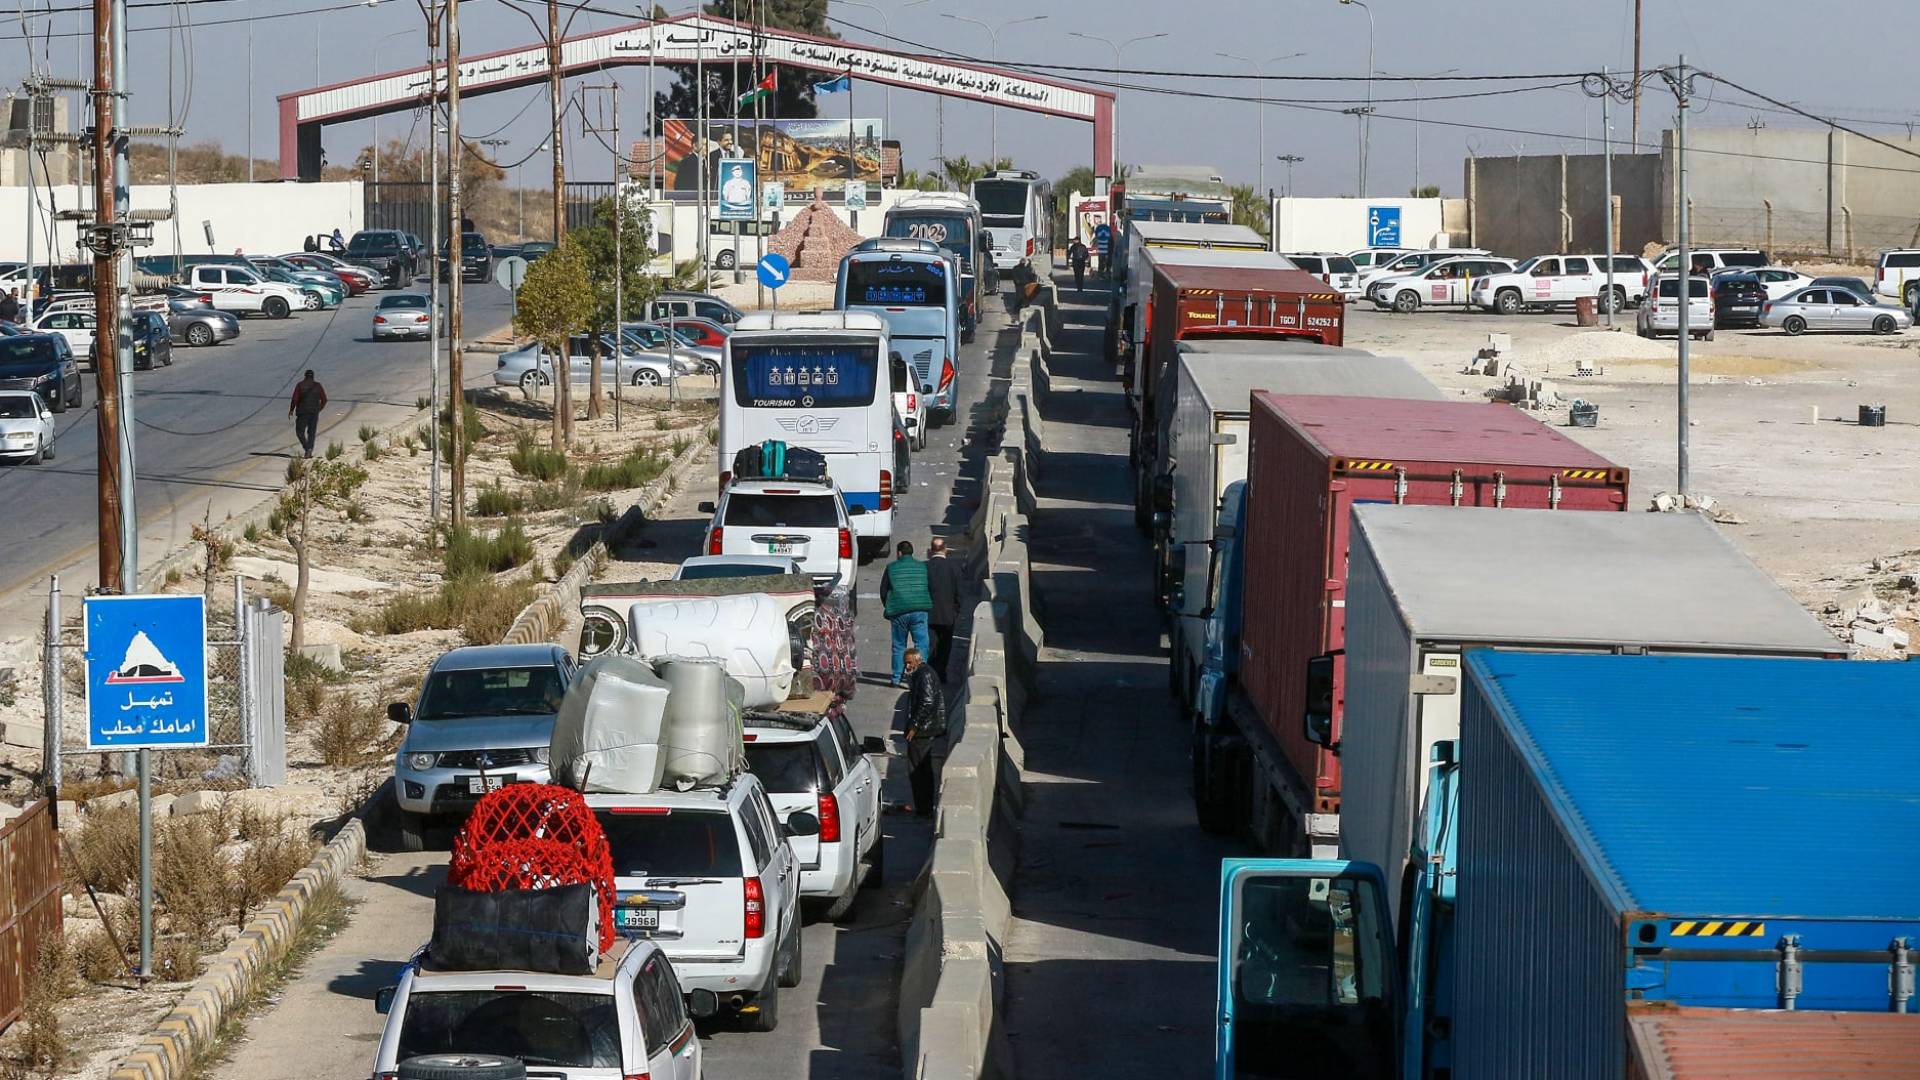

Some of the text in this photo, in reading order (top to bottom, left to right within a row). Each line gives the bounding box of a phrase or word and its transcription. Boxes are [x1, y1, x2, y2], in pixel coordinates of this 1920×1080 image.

[790, 42, 1048, 102] المملكة الأردنية الهاشمية تستودعكم السلامة
[909, 223, 947, 241] 2024
[1279, 316, 1296, 325] TGCU
[753, 399, 796, 407] TOURISMO
[120, 690, 174, 711] تمهل
[149, 718, 196, 734] امامك
[625, 917, 656, 926] 39968
